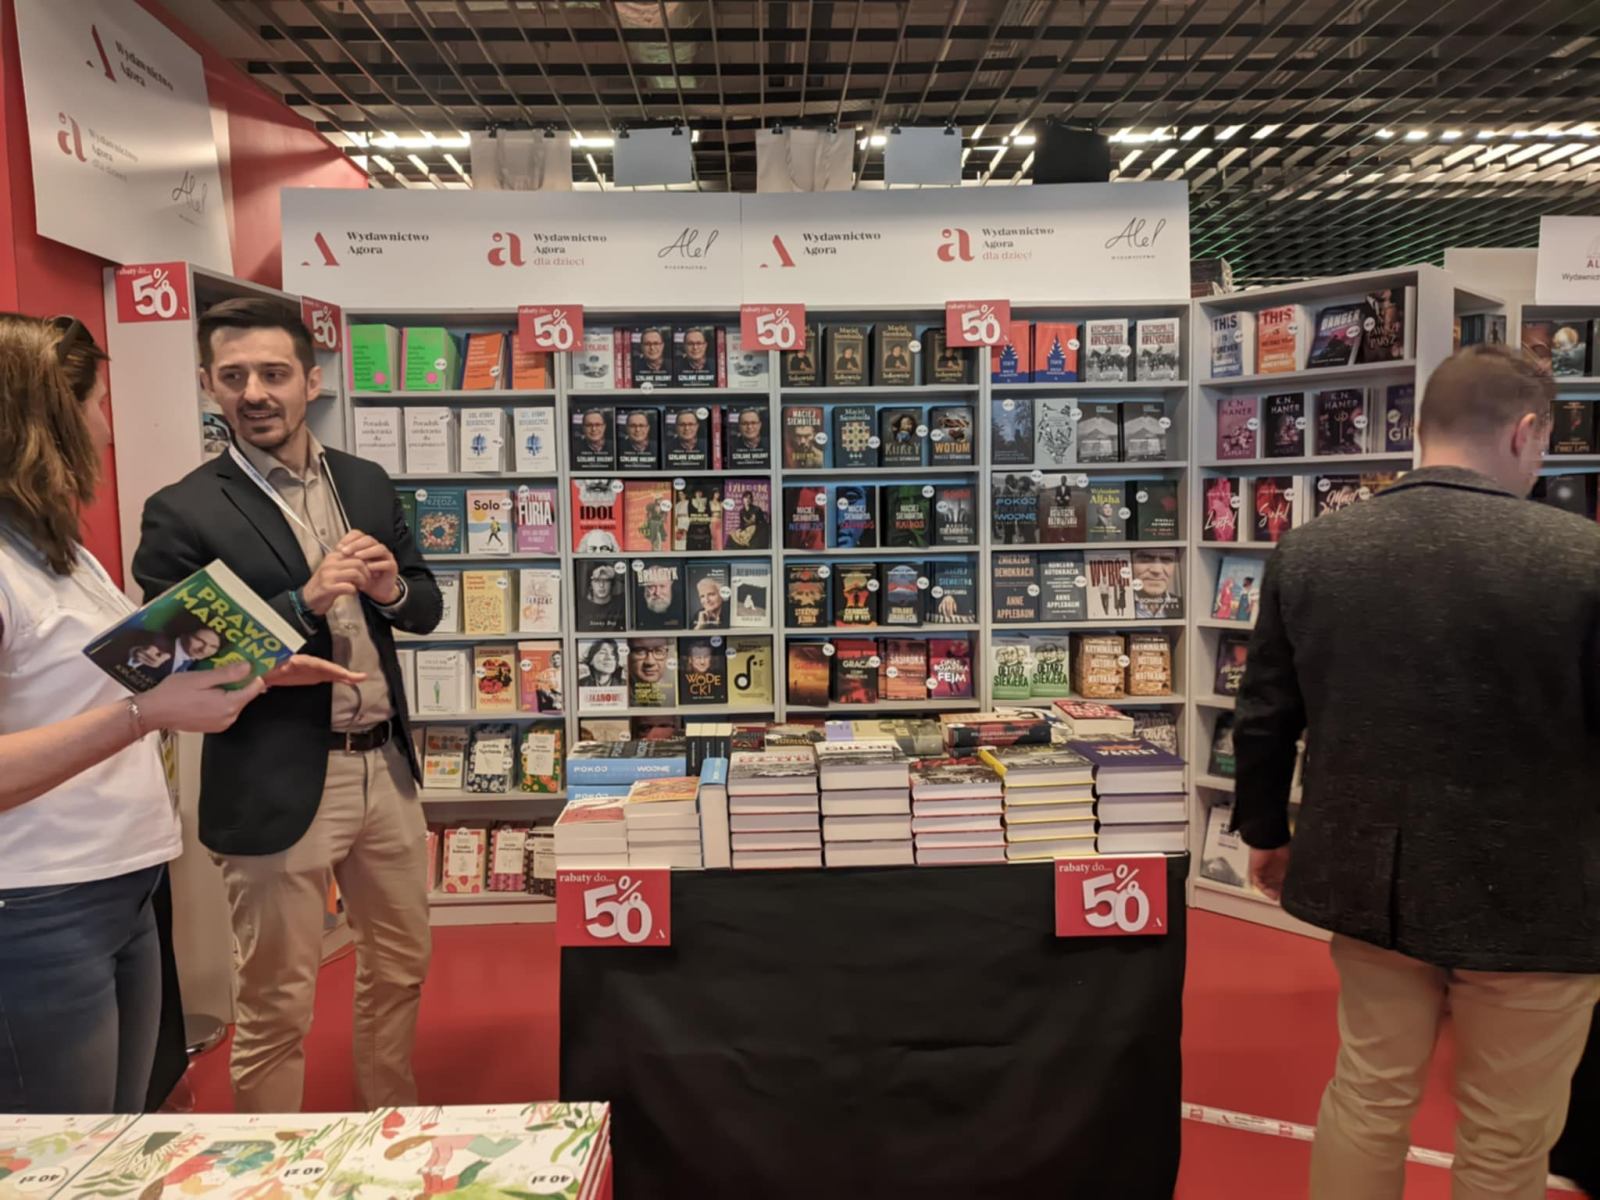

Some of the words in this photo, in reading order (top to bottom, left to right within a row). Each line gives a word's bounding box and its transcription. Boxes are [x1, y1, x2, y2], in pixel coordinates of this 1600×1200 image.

[347, 231, 429, 243] Wydawnictwo
[533, 232, 607, 243] Wydawnictwo
[802, 231, 881, 243] Wydawnictwo
[982, 226, 1055, 238] Wydawnictwo
[982, 238, 1014, 249] Agora
[347, 244, 384, 256] Agora
[533, 244, 566, 255] Agora
[802, 244, 837, 255] Agora
[982, 250, 998, 261] dla
[1001, 249, 1033, 261] dzieci
[533, 256, 552, 266] dla
[554, 256, 585, 266] dzieci
[1261, 309, 1292, 325] THIS
[1214, 315, 1237, 332] THIS
[934, 443, 970, 453] WOTUM
[474, 500, 500, 511] Solo
[518, 501, 552, 526] FURIA
[580, 505, 616, 520] IDOL
[196, 586, 282, 651] PRAWO
[175, 588, 277, 670] MARCINA
[937, 672, 967, 683] FEJM
[1059, 863, 1090, 873] rabaty
[559, 873, 591, 883] rabaty
[302, 1166, 324, 1176] 40
[38, 1173, 60, 1183] 40
[549, 1174, 571, 1184] 40
